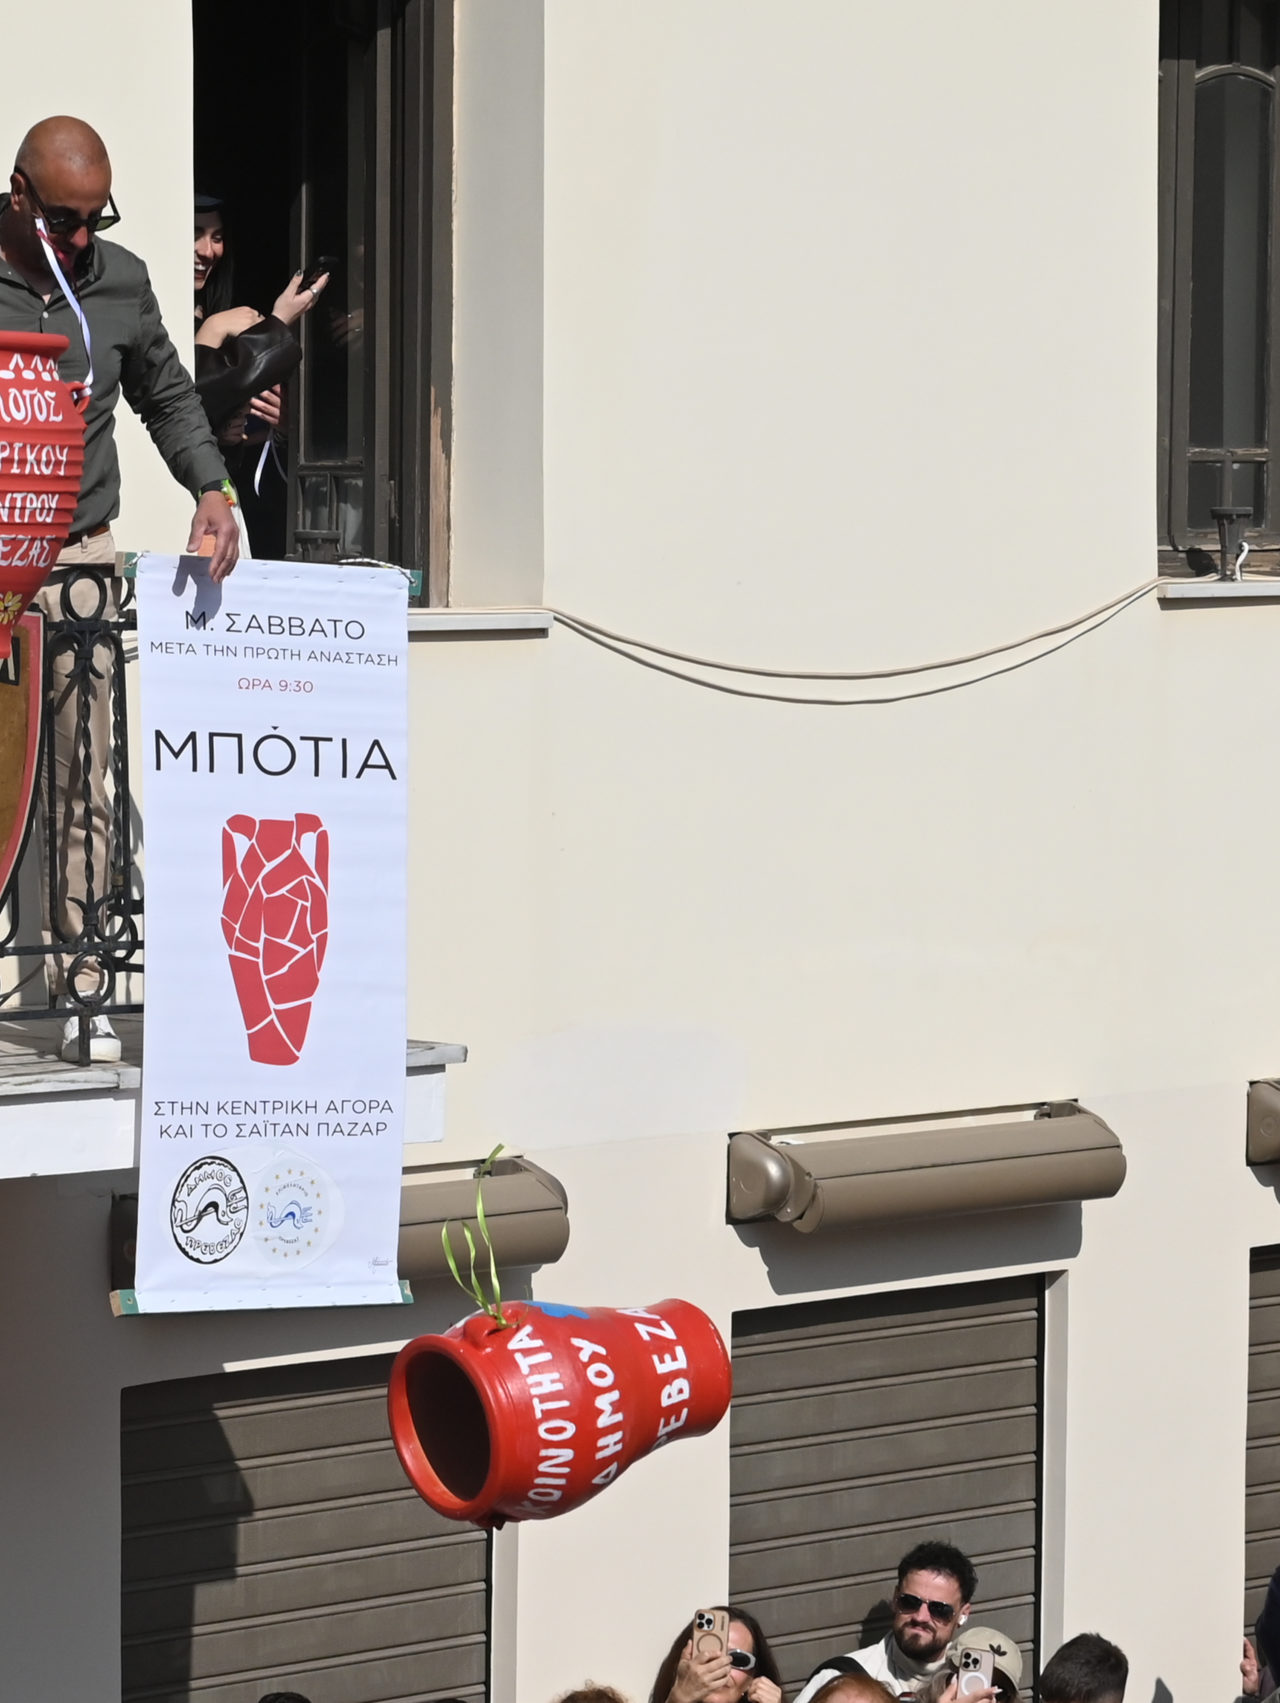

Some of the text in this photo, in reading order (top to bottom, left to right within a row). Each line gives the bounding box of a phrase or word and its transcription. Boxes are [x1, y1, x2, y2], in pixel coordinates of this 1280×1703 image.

[185, 610, 366, 640] Μ. ΣΑΒΒΑΤΟ
[150, 641, 398, 667] ΜΕΤΑ ΤΗΝ ΠΡΩΤΗ ΑΝΑΣΤΑΣΗ
[237, 677, 314, 694] ΩΡΑ 9:30
[153, 1099, 394, 1116] ΣΤΗΝ ΚΕΝΤΡΙΚΗ ΑΓΟΡΑ
[160, 1120, 388, 1139] ΚΑΙ ΤΟ ΣΑΪΤΑΝ ΠΑΖΑΡ
[570, 1337, 624, 1485] ΔΗΜΟΥ
